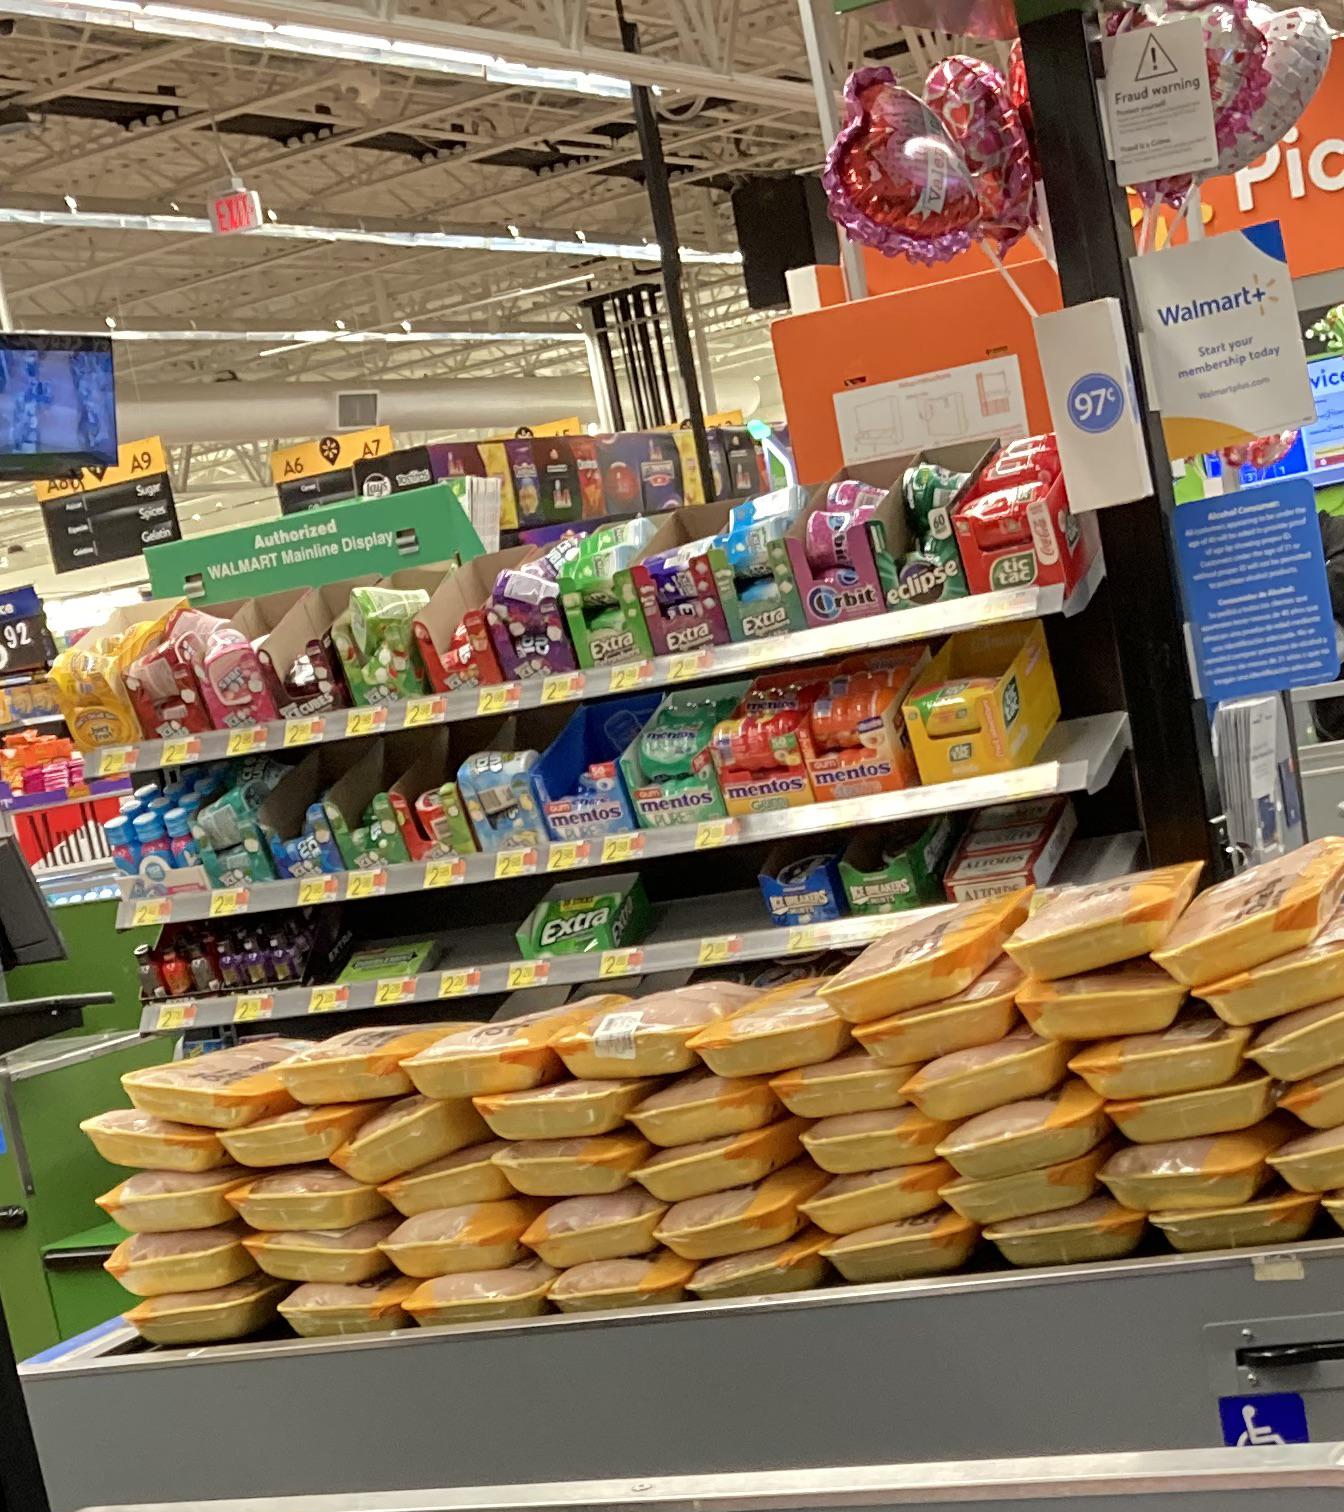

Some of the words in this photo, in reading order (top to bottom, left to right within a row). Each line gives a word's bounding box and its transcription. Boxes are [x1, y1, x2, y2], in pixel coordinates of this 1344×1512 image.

[1115, 86, 1149, 105] Fraud
[1152, 77, 1200, 96] warning
[1158, 286, 1266, 326] Walmart+
[1198, 342, 1226, 358] Start
[1228, 336, 1254, 351] your
[1178, 353, 1247, 379] membership
[1249, 345, 1280, 362] today
[130, 451, 152, 475] A9
[283, 456, 304, 478] A6
[362, 439, 381, 461] A7
[135, 482, 161, 498] Sugar
[138, 504, 166, 521] Spices
[141, 528, 172, 543] Gelatin
[254, 517, 338, 549] Authorized
[207, 551, 279, 580] WALMART
[281, 542, 339, 565] Mainline
[341, 531, 395, 553] Display
[1006, 553, 1029, 571] tic
[886, 559, 958, 605] eclipse
[998, 567, 1031, 585] tac
[809, 583, 878, 622] Orbit
[742, 607, 786, 636] Extra
[590, 632, 634, 659] Extra
[667, 622, 709, 650] Extra
[814, 761, 891, 787] mentos
[640, 791, 713, 812] mentos
[727, 776, 804, 800] mentos
[550, 804, 623, 828] mentos
[540, 907, 610, 946] Extra
